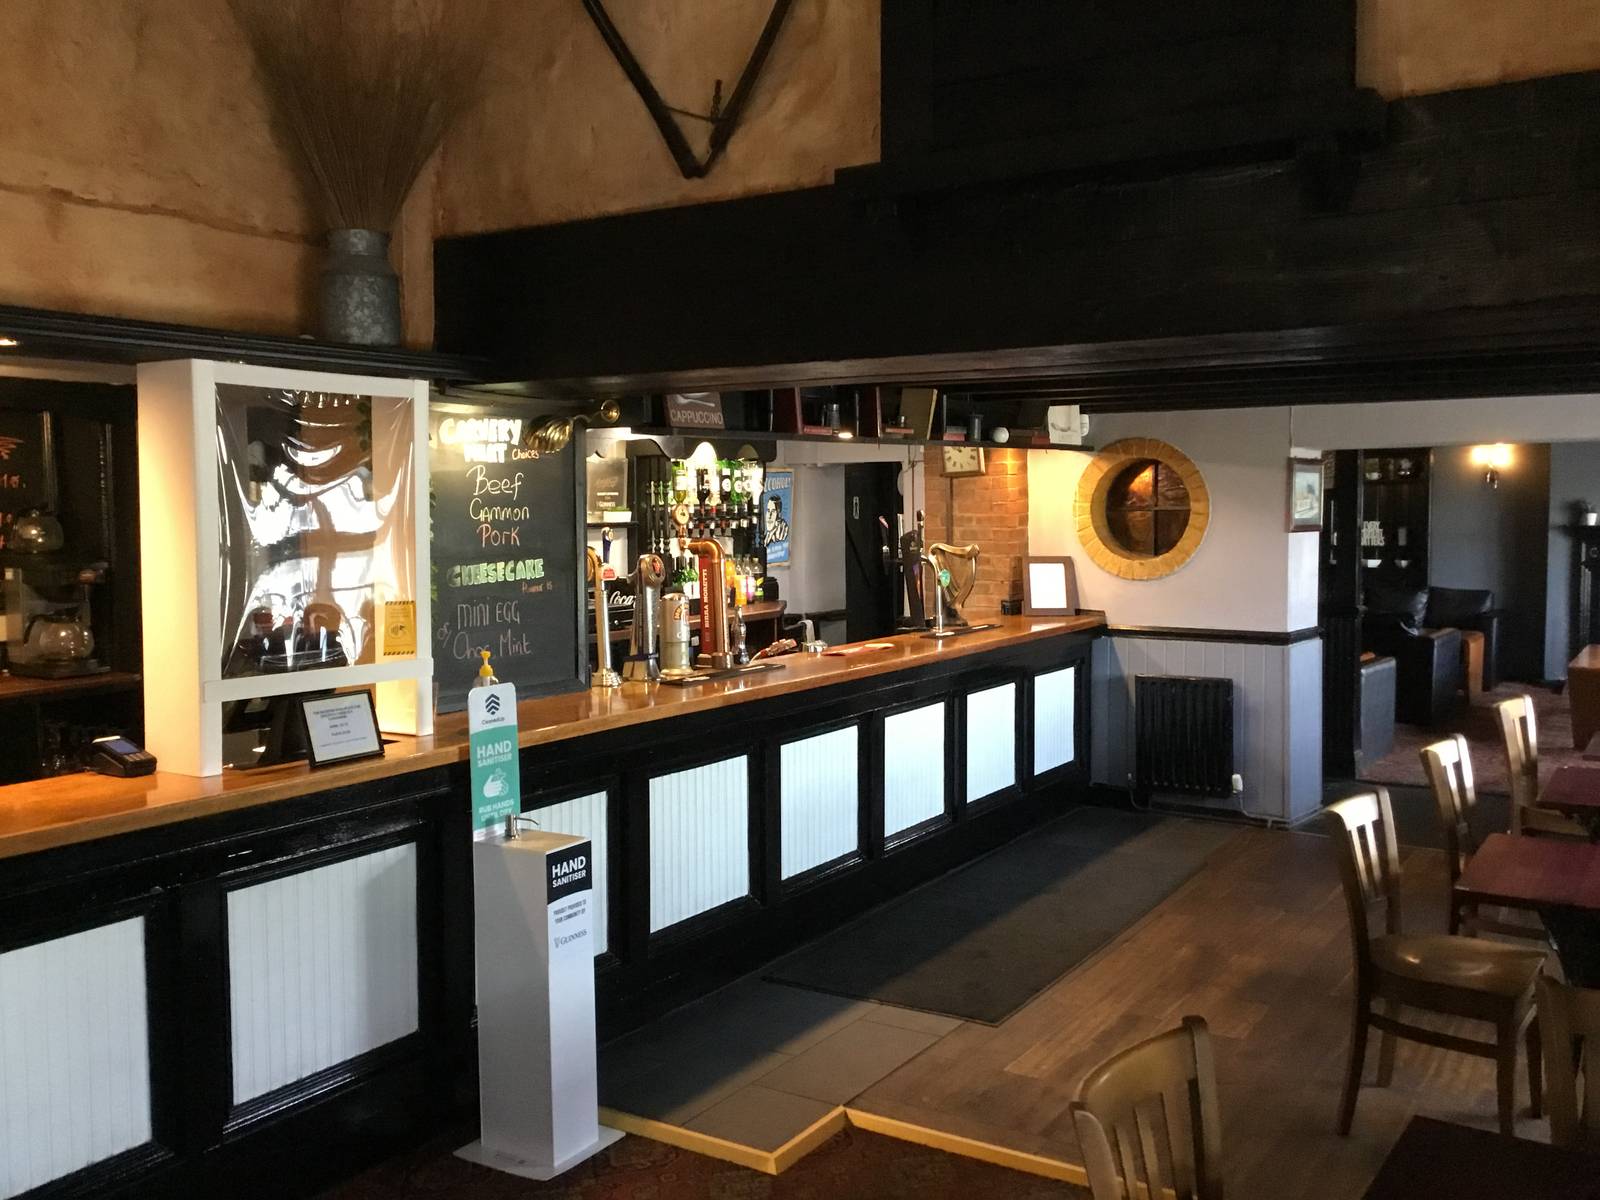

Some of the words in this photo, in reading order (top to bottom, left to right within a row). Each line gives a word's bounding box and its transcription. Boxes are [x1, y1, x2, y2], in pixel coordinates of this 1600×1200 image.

[671, 409, 723, 425] CAPPUCCINO
[512, 448, 540, 460] Choices
[466, 465, 524, 501] Beef
[446, 558, 545, 588] CHEESECAKE
[496, 599, 521, 624] EGG
[500, 628, 534, 657] Mint
[476, 740, 512, 759] HAND
[477, 752, 513, 767] SANITISER
[552, 856, 587, 879] HAND
[552, 870, 587, 888] SANITISER
[560, 928, 588, 945] GUINNESS
